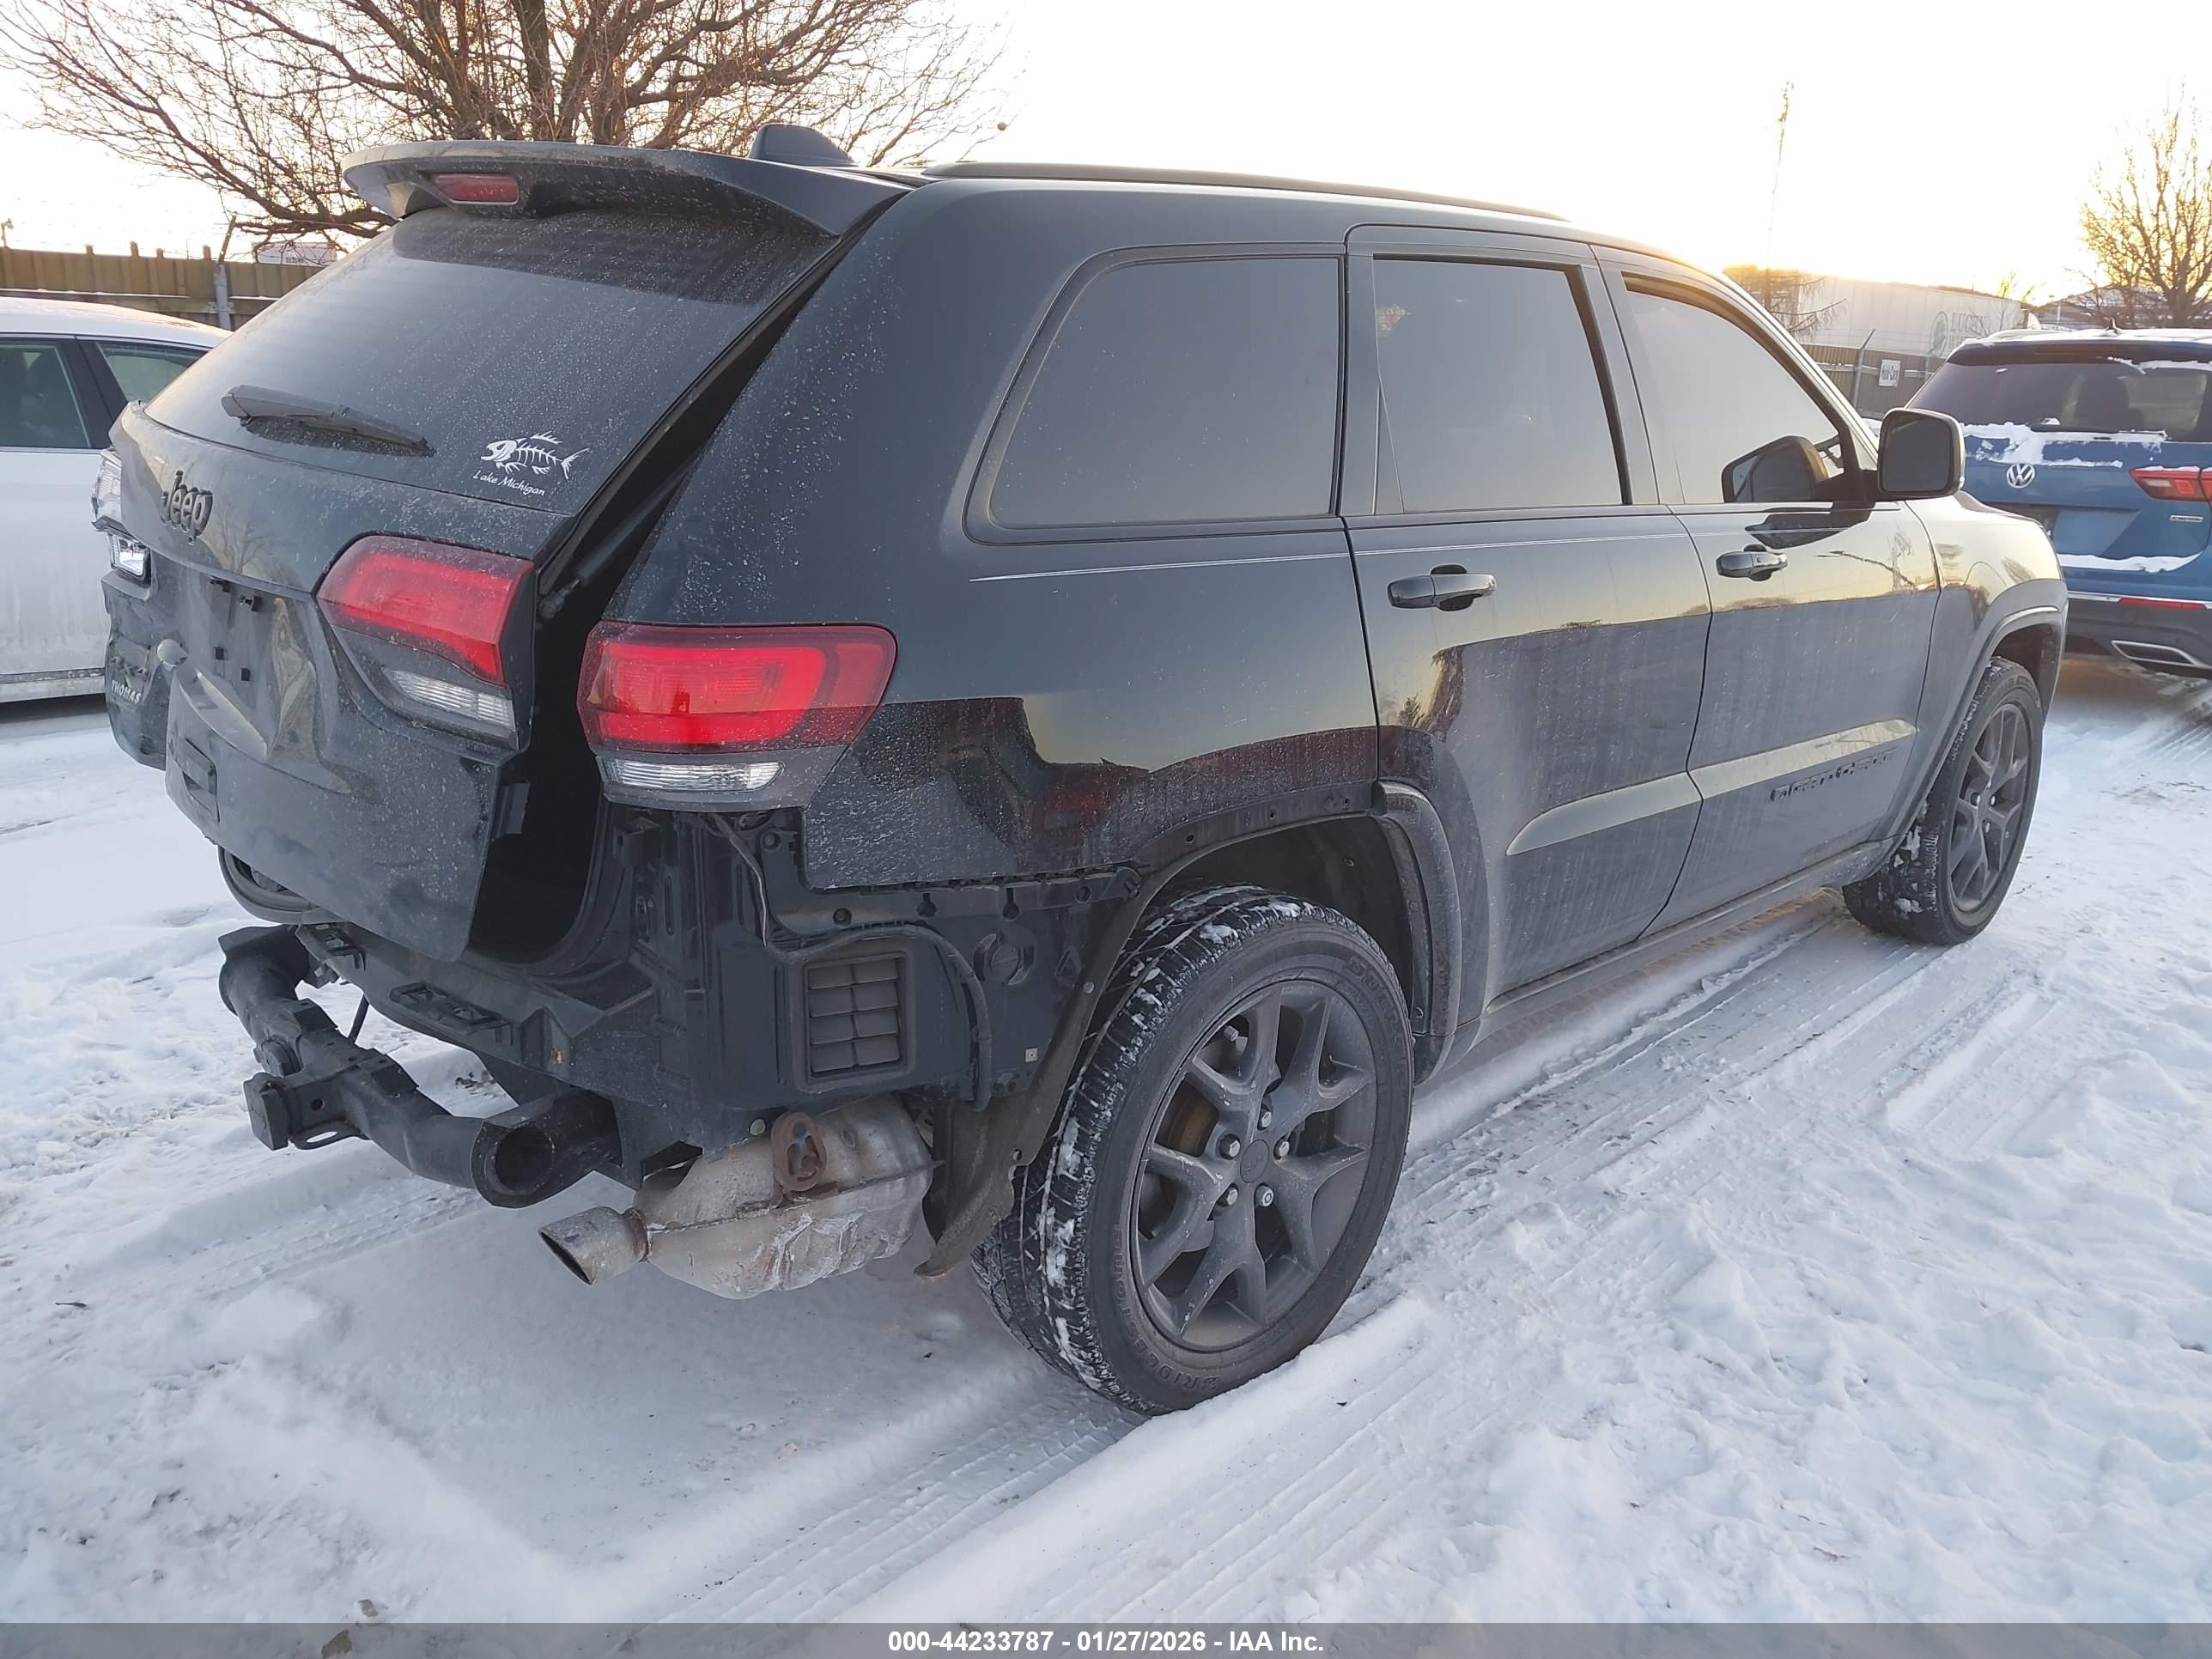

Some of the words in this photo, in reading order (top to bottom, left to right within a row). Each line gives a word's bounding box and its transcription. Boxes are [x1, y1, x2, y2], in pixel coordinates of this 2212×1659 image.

[472, 470, 498, 483] Lake
[498, 476, 545, 495] Michigan
[160, 470, 213, 544] Jeep
[111, 679, 142, 704] THOMAS
